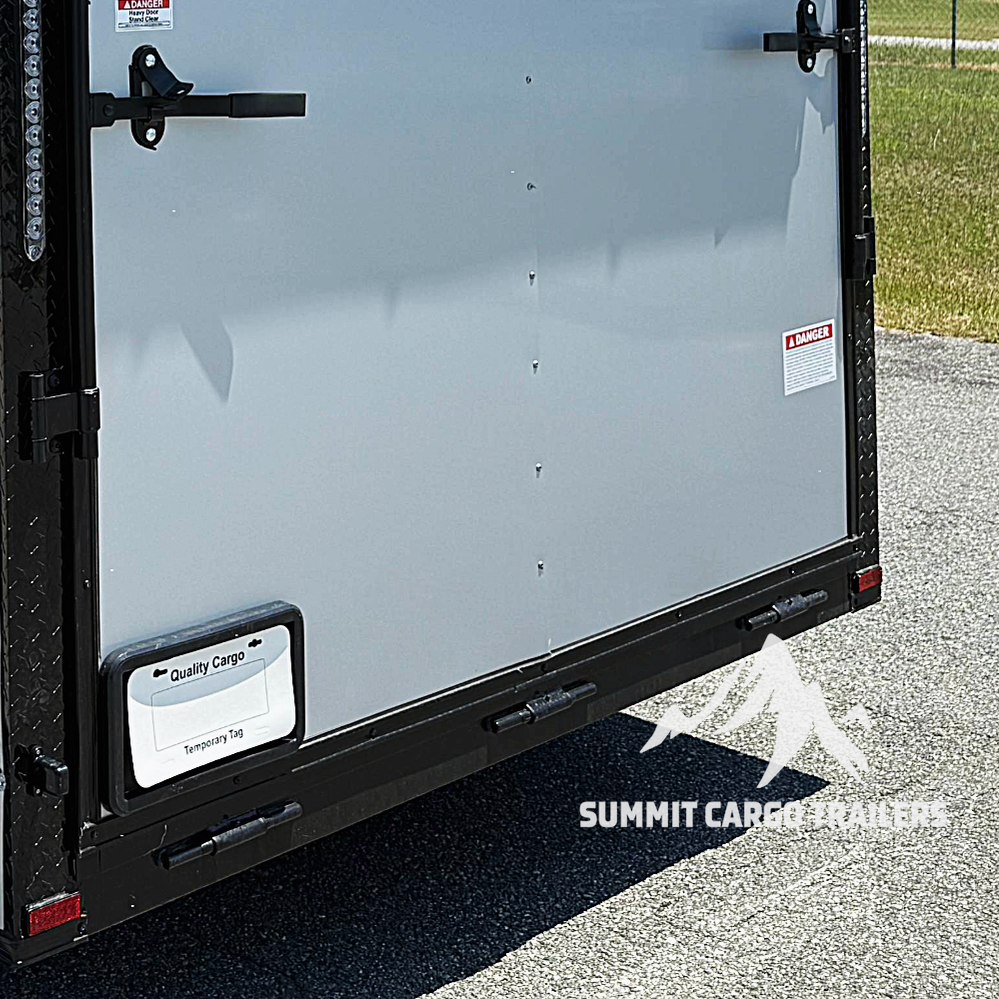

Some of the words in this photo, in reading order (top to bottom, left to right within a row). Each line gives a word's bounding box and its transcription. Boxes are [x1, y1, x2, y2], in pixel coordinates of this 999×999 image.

[131, 0, 163, 8] DANGER
[796, 326, 829, 345] DANGER
[171, 661, 209, 681] Quality
[212, 651, 245, 668] Cargo
[184, 734, 227, 755] Temporary
[229, 728, 243, 739] Tag
